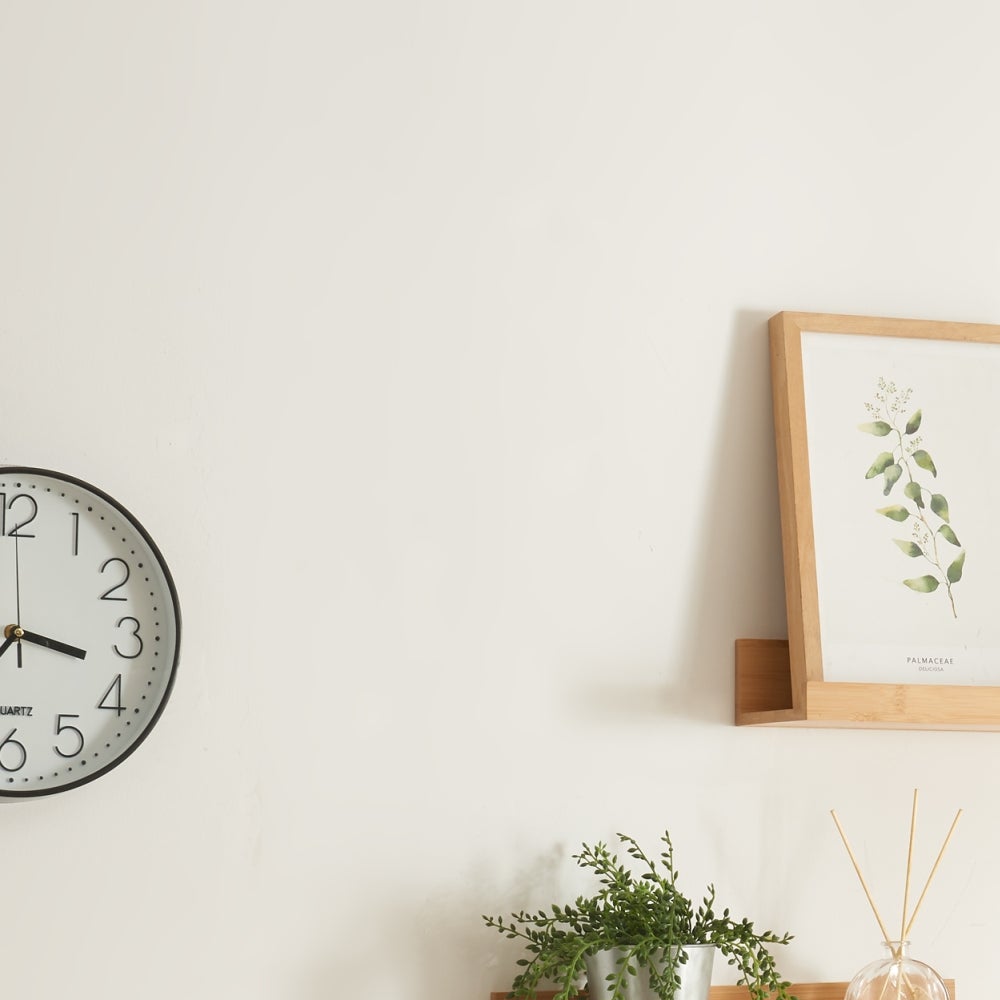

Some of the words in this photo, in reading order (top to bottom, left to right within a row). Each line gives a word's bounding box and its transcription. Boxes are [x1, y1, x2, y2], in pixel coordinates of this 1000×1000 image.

[0, 492, 38, 538] 12
[70, 512, 79, 556] 1
[99, 557, 130, 601] 2
[113, 616, 143, 659] 3
[906, 657, 954, 665] PALMACEAE
[0, 705, 33, 717] UARTZ
[97, 673, 127, 717] 4
[0, 728, 27, 772] 6
[55, 714, 84, 758] 5
